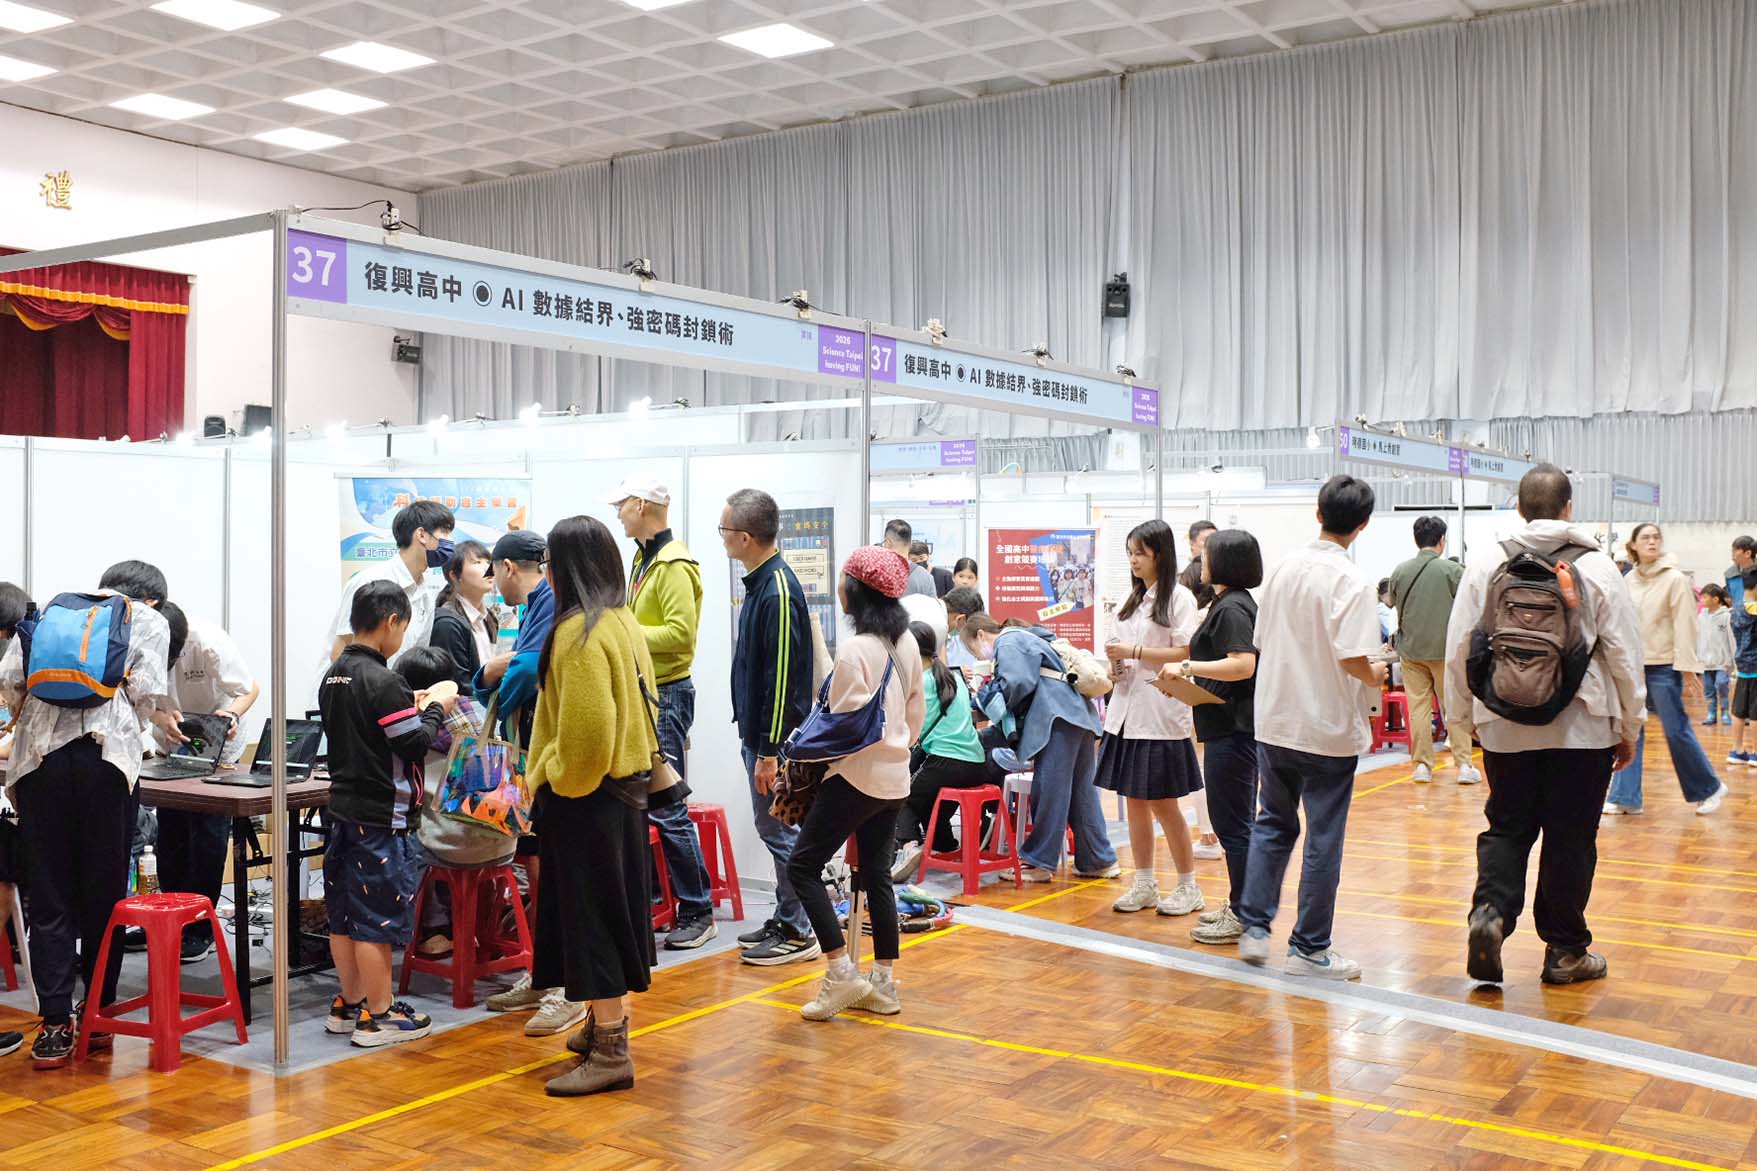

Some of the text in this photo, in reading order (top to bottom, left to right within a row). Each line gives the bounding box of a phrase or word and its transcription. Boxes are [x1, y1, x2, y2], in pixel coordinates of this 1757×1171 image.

[39, 169, 73, 211] 禮
[291, 246, 337, 287] 37
[364, 261, 735, 346] 復興高中 AI 數據結界、強密碼封鎖術
[822, 346, 864, 361] Science Taipei
[835, 335, 851, 345] 2026
[824, 359, 845, 373] having
[871, 345, 892, 372] 37
[904, 353, 1088, 405] 復興高中 AI 數據結界、強密碼封鎖術
